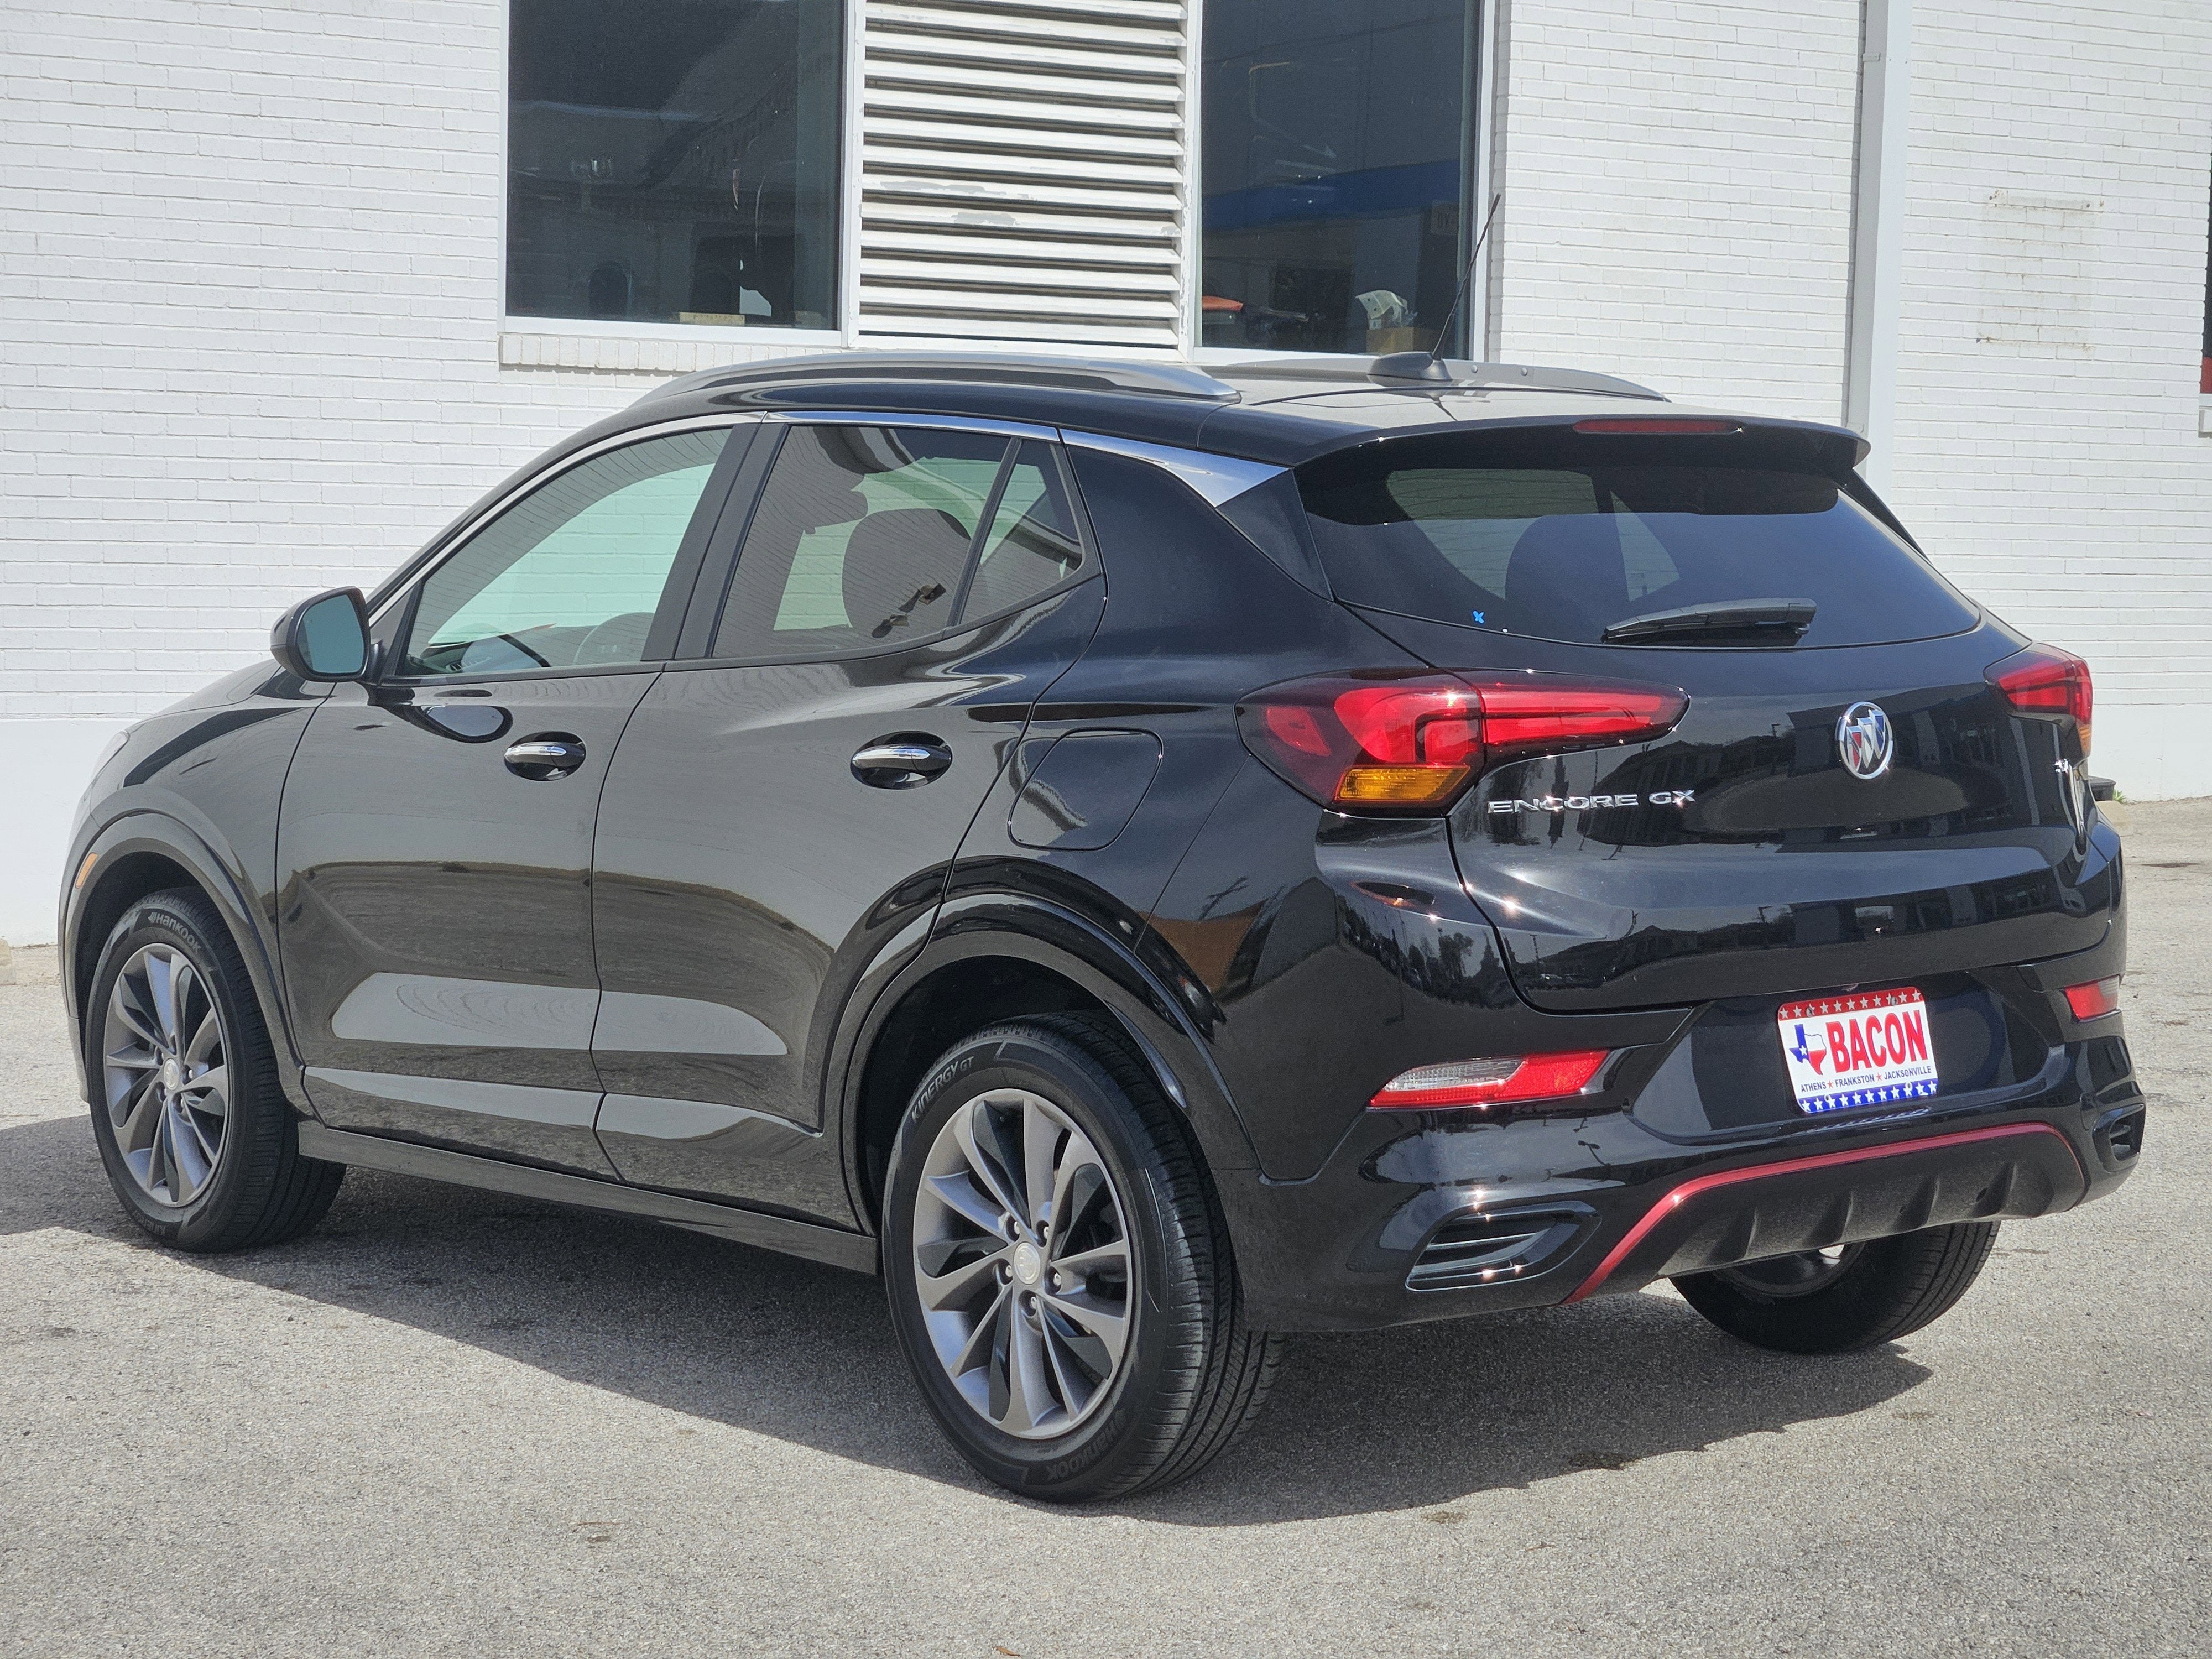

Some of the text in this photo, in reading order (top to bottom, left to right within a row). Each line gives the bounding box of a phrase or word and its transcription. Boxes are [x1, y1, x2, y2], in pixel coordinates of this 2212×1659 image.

[1488, 790, 1695, 813] ENCORE GX
[1826, 1010, 1928, 1073] BACON
[960, 1056, 974, 1072] GT
[1801, 1066, 1932, 1093] ATHENS FRANKSTON JACKSONVILLE
